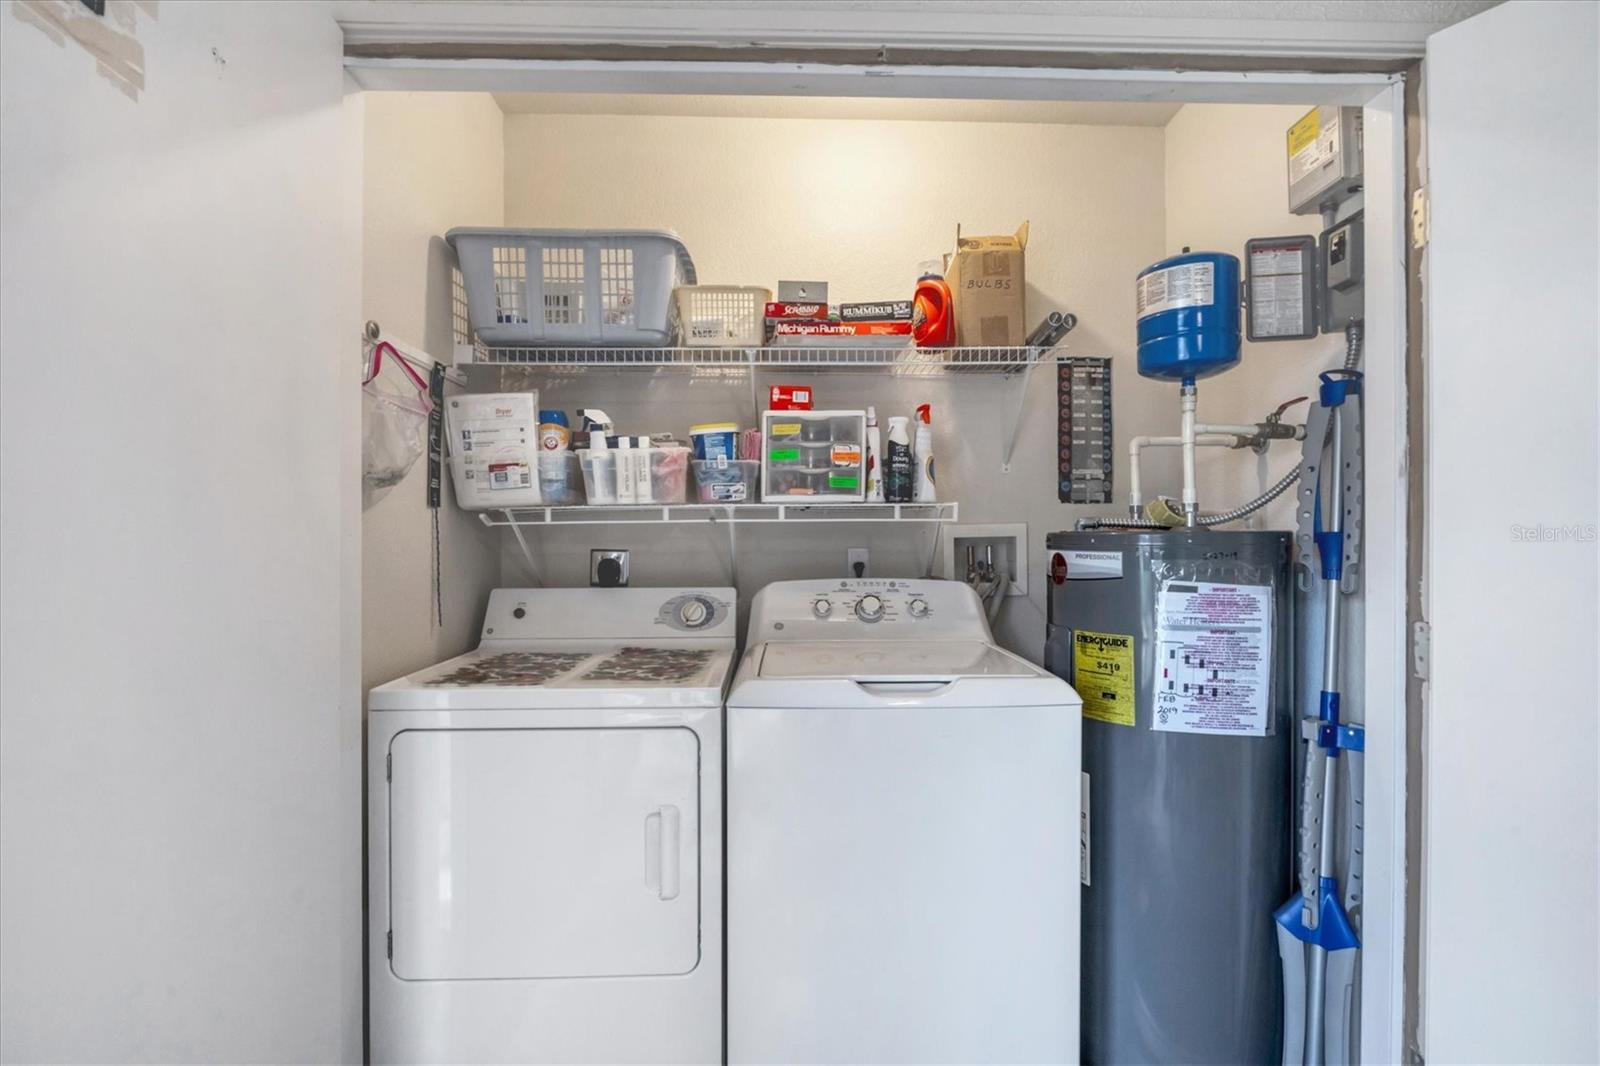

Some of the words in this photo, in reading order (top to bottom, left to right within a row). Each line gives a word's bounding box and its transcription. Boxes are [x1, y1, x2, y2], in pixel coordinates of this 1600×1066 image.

[967, 279, 1012, 289] BULBS
[843, 306, 893, 316] RUMMIKUB
[777, 324, 818, 335] Michigan
[820, 325, 856, 335] Rummy
[1097, 661, 1120, 671] $419
[1157, 705, 1178, 715] 2019
